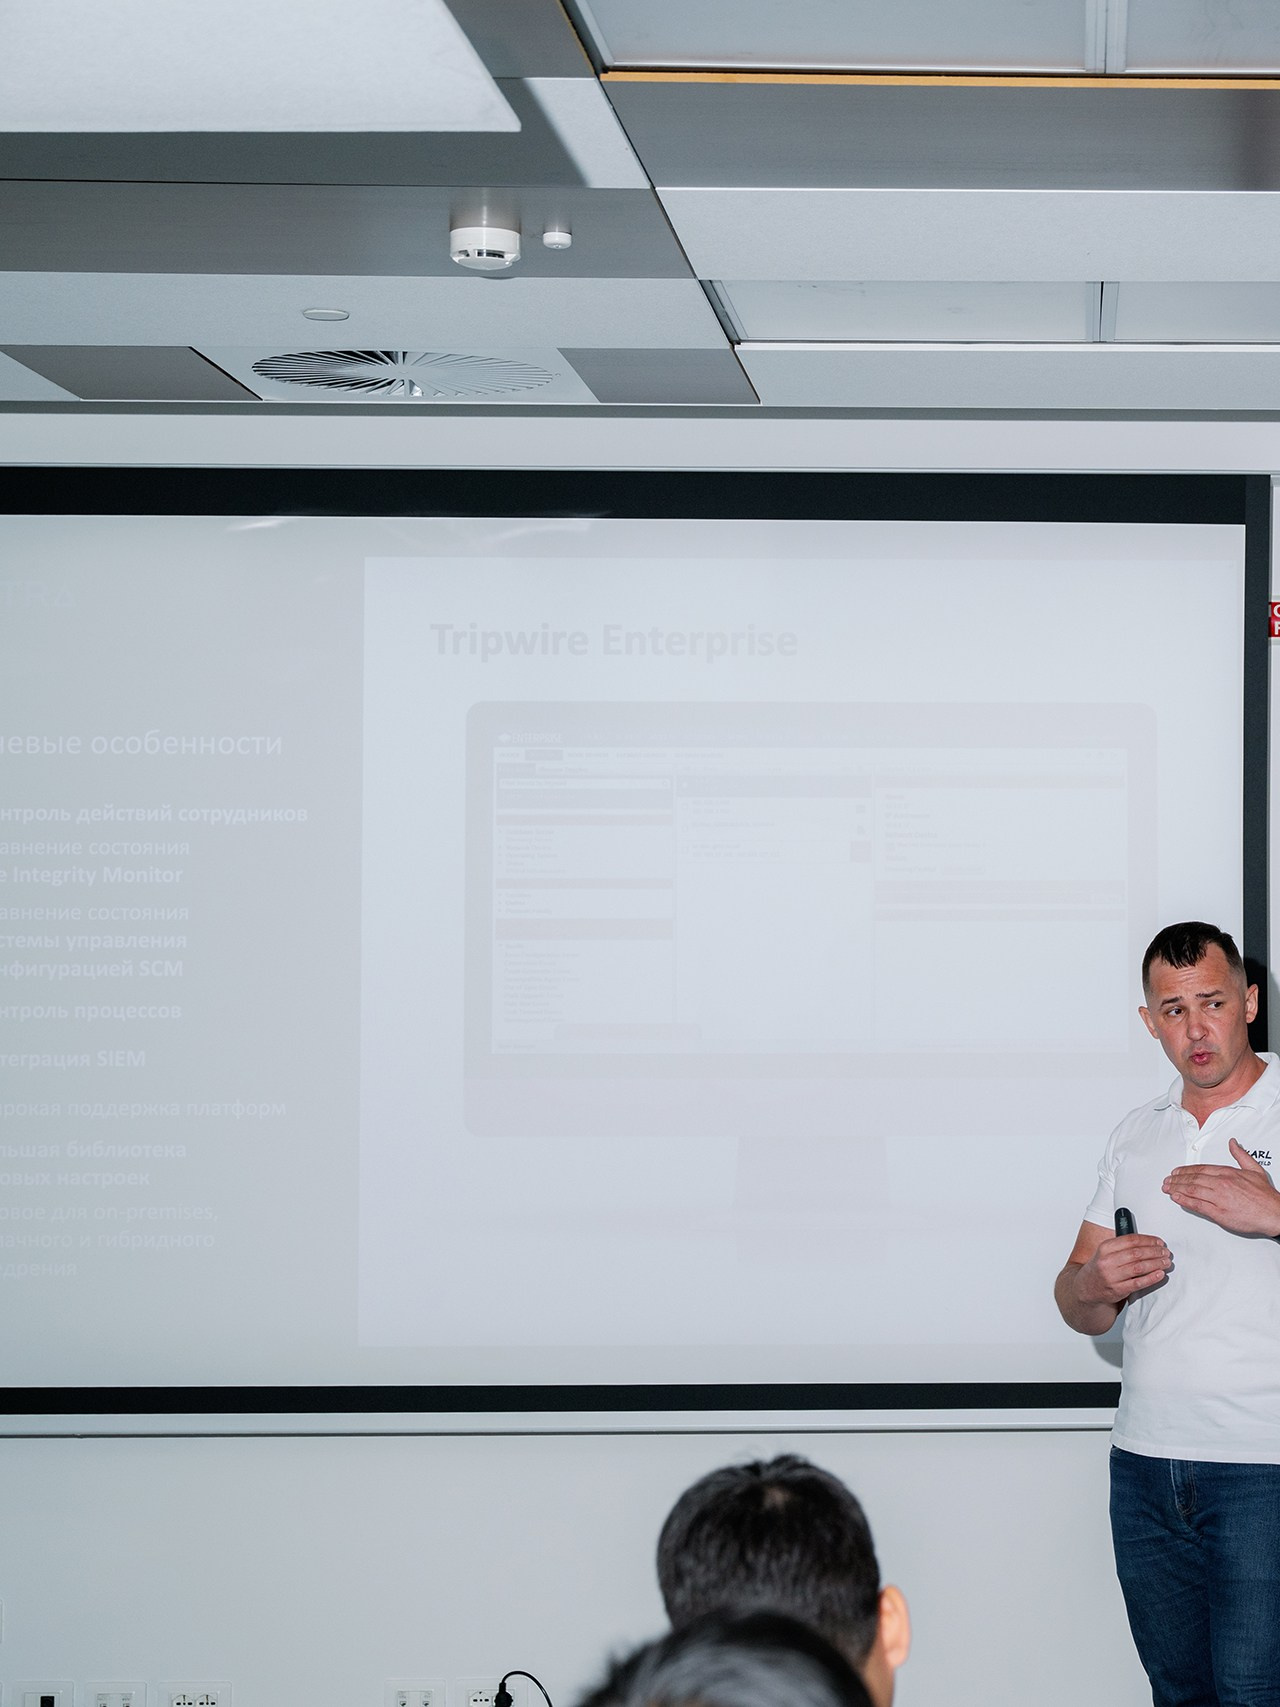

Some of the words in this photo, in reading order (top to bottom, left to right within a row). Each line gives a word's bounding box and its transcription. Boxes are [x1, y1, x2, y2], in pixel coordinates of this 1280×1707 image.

[430, 622, 590, 663] Tripwire
[602, 623, 799, 665] Enterprise
[90, 729, 283, 755] особенности
[76, 803, 173, 825] действий
[177, 807, 309, 826] сотрудников
[88, 841, 191, 856] состояния
[12, 866, 98, 887] Integrity
[102, 865, 184, 884] Monitor
[87, 906, 190, 921] состояния
[66, 934, 188, 952] управления
[138, 960, 184, 978] SCM
[73, 1005, 183, 1022] процессов
[96, 1051, 147, 1068] SIEM
[67, 1102, 181, 1119] поддержка
[186, 1099, 287, 1120] платформ
[65, 1140, 187, 1158] библиотека
[1245, 1149, 1272, 1160] ARL
[56, 1172, 151, 1189] настроек
[50, 1206, 88, 1222] для
[78, 1234, 92, 1248] и
[97, 1231, 216, 1251] гибридного
[0, 1262, 77, 1278] дрения
